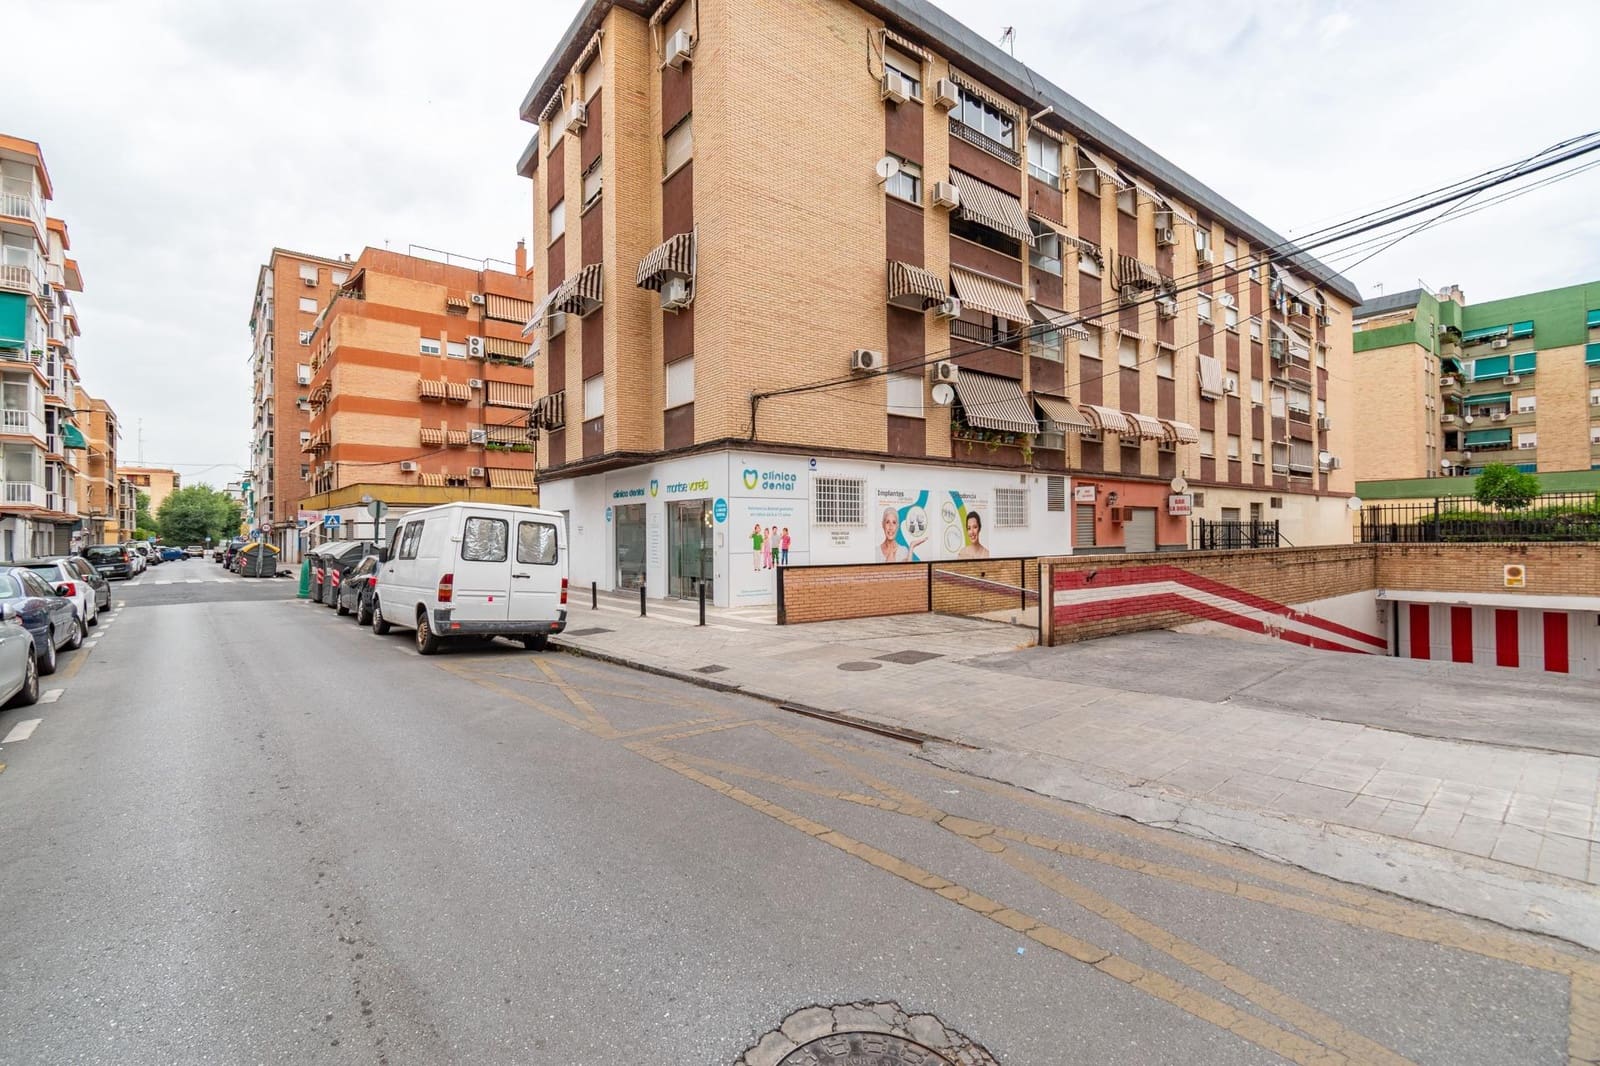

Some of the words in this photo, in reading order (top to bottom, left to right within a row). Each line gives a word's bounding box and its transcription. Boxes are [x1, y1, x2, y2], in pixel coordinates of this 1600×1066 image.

[762, 481, 795, 492] dental
[629, 487, 645, 498] dental
[877, 489, 904, 498] Implantes
